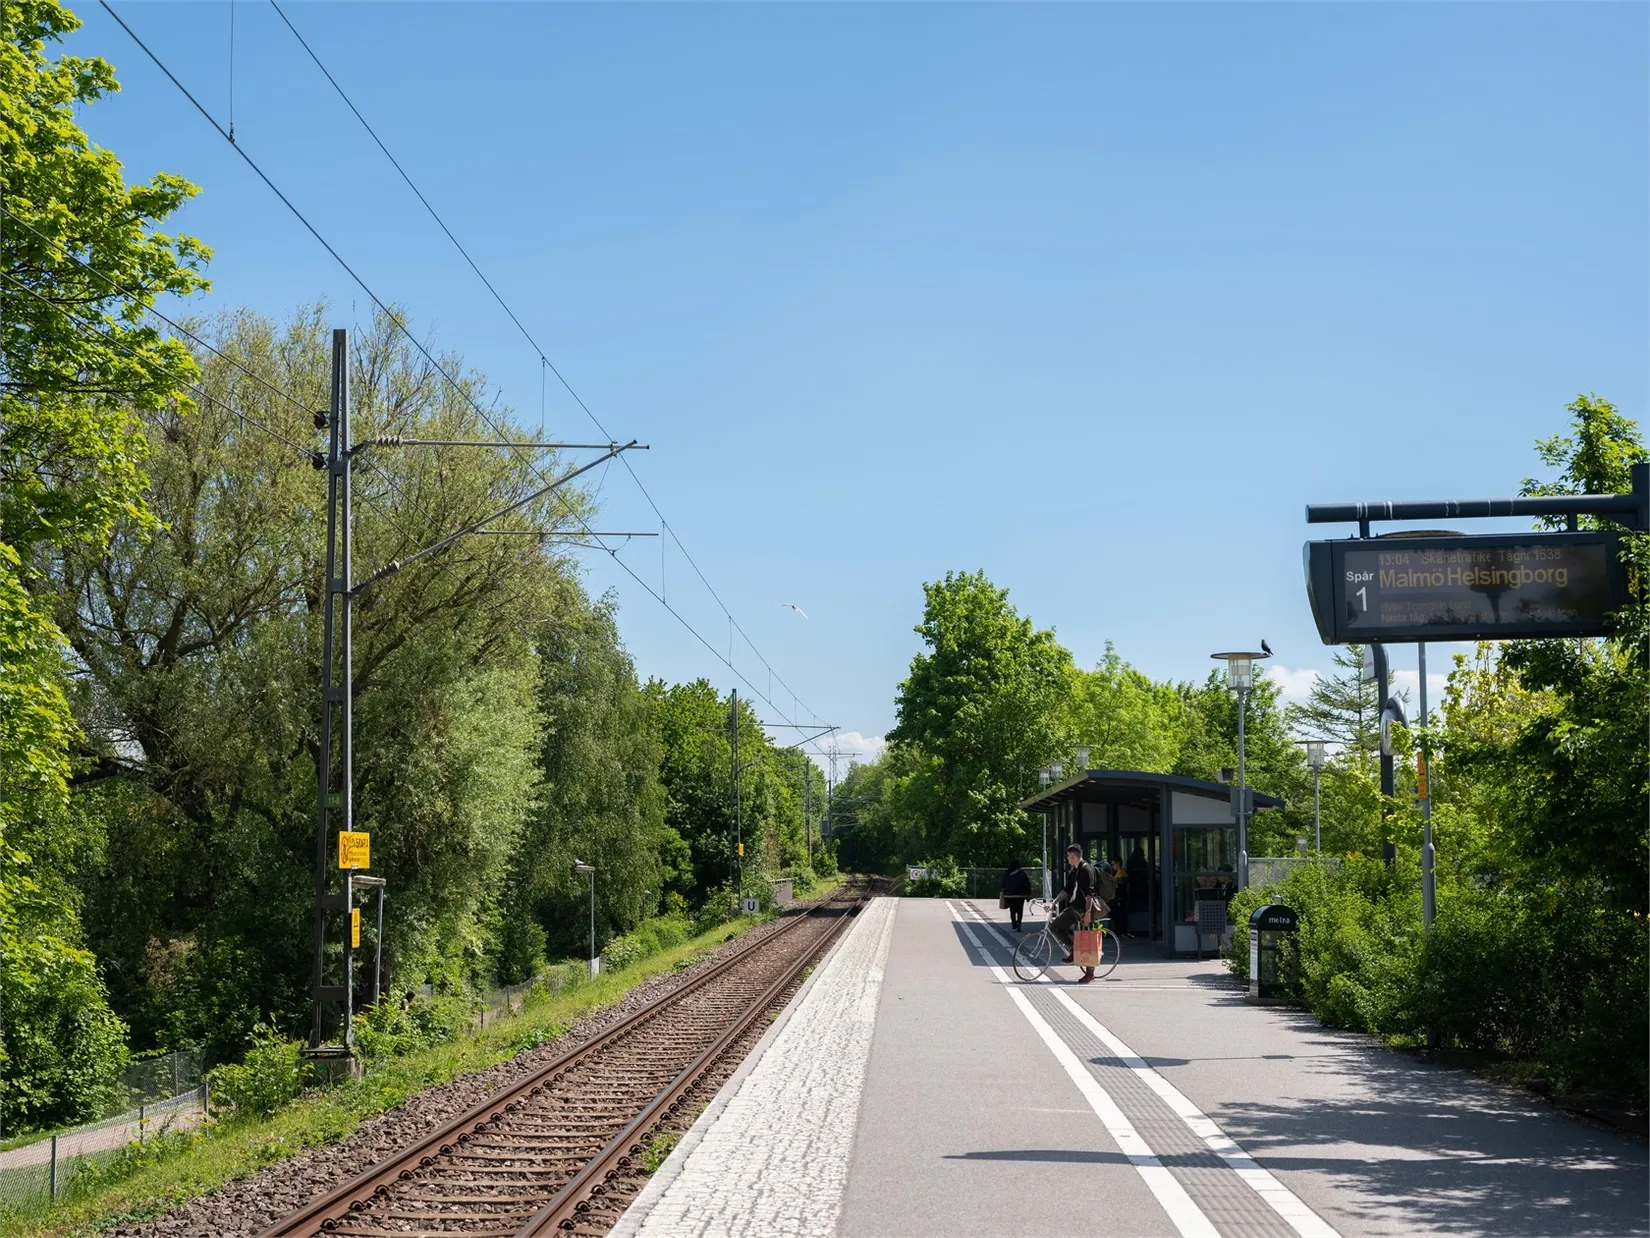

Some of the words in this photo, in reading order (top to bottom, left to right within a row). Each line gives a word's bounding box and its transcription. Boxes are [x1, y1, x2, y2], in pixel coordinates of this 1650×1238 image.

[1379, 553, 1409, 566] 13:04
[1498, 550, 1530, 564] Tågnr
[1534, 548, 1562, 560] 1538
[1346, 570, 1374, 582] Spår
[1379, 567, 1444, 588] Malmö
[1447, 565, 1568, 589] Helsingborg
[1356, 587, 1368, 612] 1
[748, 901, 755, 911] U
